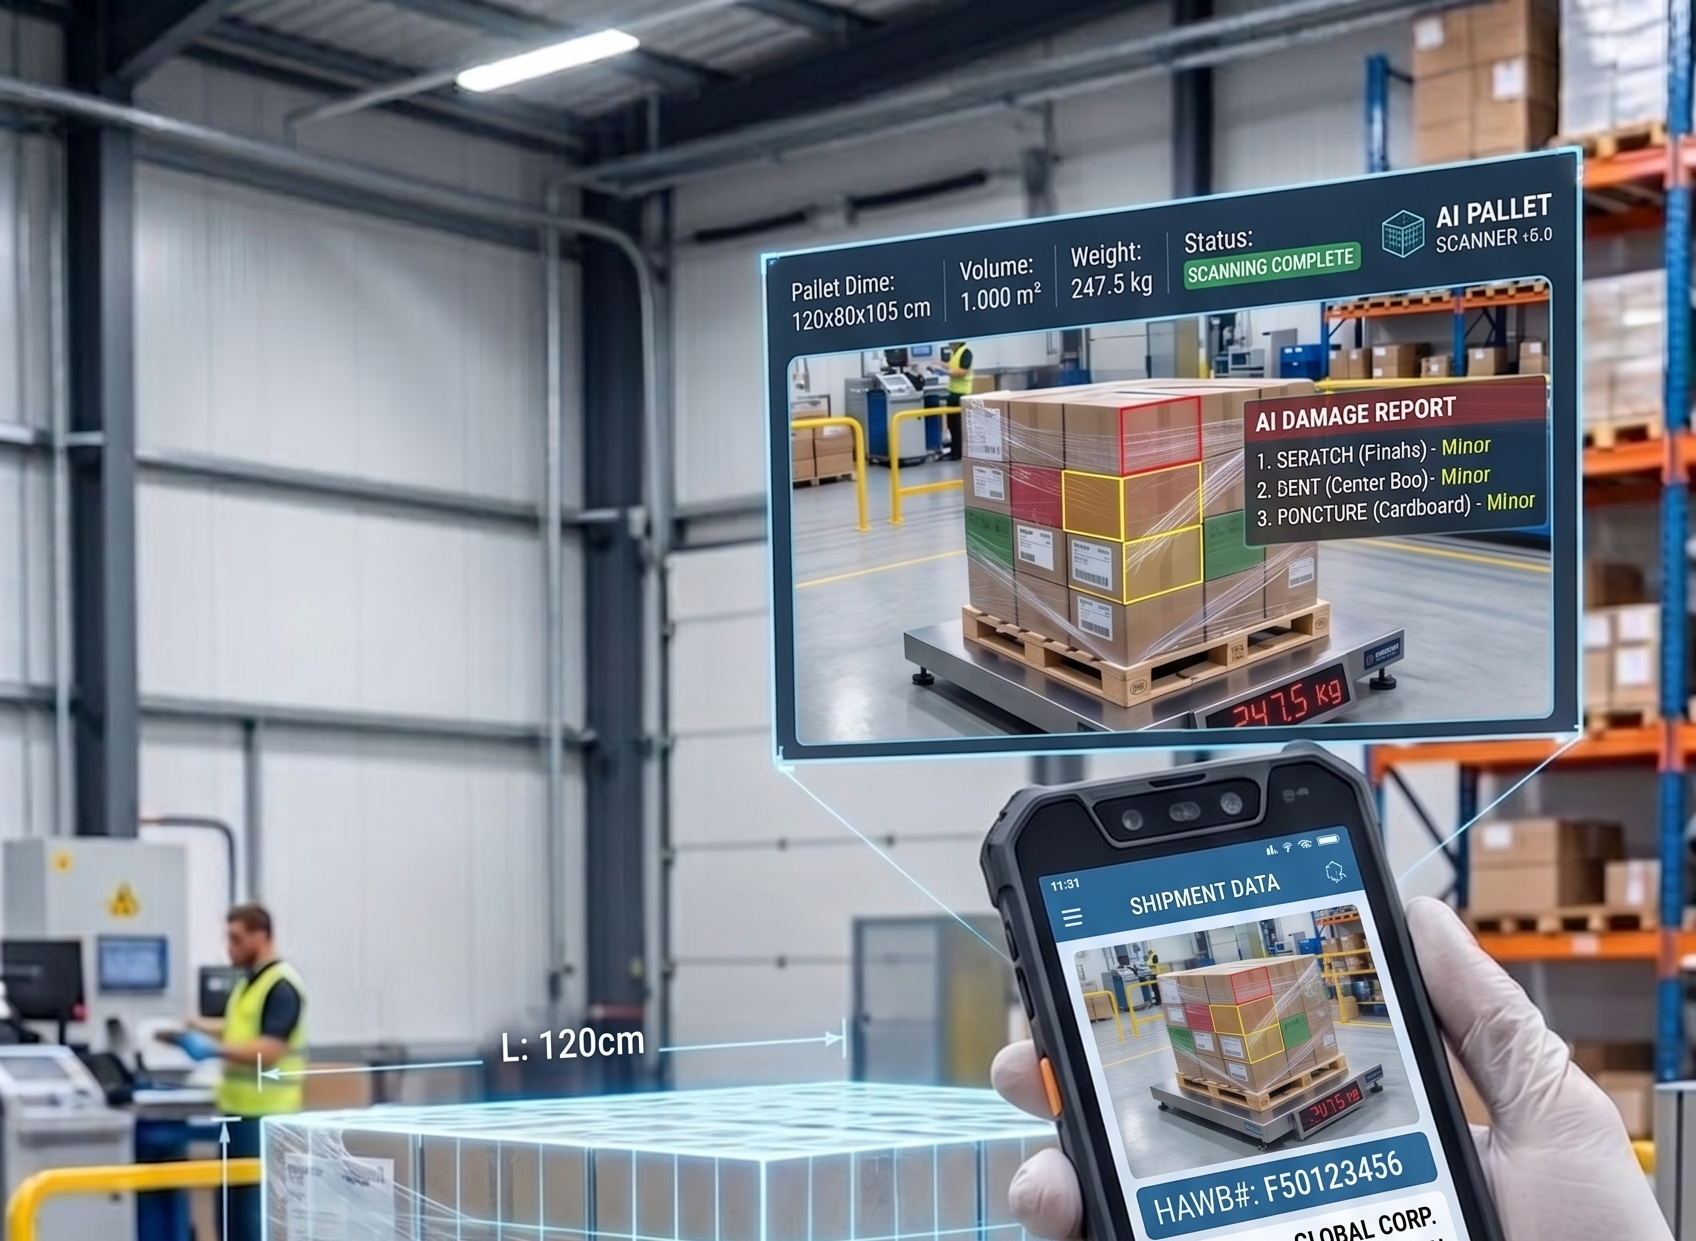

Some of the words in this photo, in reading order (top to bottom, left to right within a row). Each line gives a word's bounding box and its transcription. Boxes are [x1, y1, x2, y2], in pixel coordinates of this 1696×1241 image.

[1436, 205, 1459, 228] AI
[1467, 193, 1552, 224] PALLET
[1071, 241, 1142, 269] Weight:
[1184, 229, 1253, 254] Status:
[1436, 227, 1518, 253] SCANNER
[960, 258, 1034, 281] Volume:
[1187, 257, 1268, 284] SCANNING
[1271, 247, 1354, 273] COMPLETE
[845, 275, 895, 296] Dime:
[961, 287, 1011, 312] 1.000
[1071, 273, 1125, 299] 247.5
[1131, 271, 1153, 297] kg
[792, 301, 899, 331] 120x80x105
[904, 301, 931, 319] cm
[1255, 412, 1276, 432] AI
[1282, 404, 1369, 430] DAMAGE
[1375, 396, 1457, 422] REPORT
[1257, 453, 1272, 470] 1.
[1276, 445, 1354, 469] SERATCH
[1359, 439, 1427, 467] (Finahs)
[1442, 438, 1491, 456] Minor
[1257, 482, 1272, 499] 2.
[1325, 475, 1386, 499] (Center
[1441, 467, 1491, 486] Minor
[1257, 509, 1272, 527] 3.
[1278, 502, 1368, 525] PONCTURE
[1373, 493, 1471, 525] (Cardboard)
[1487, 492, 1536, 511] Minor
[1050, 877, 1080, 892] 11:31
[1129, 881, 1227, 916] SHIPMENT
[1230, 873, 1282, 898] DATA
[1153, 1183, 1261, 1226] HAWB#:
[1263, 1150, 1404, 1203] F50123456
[1378, 1206, 1438, 1236] CORP.
